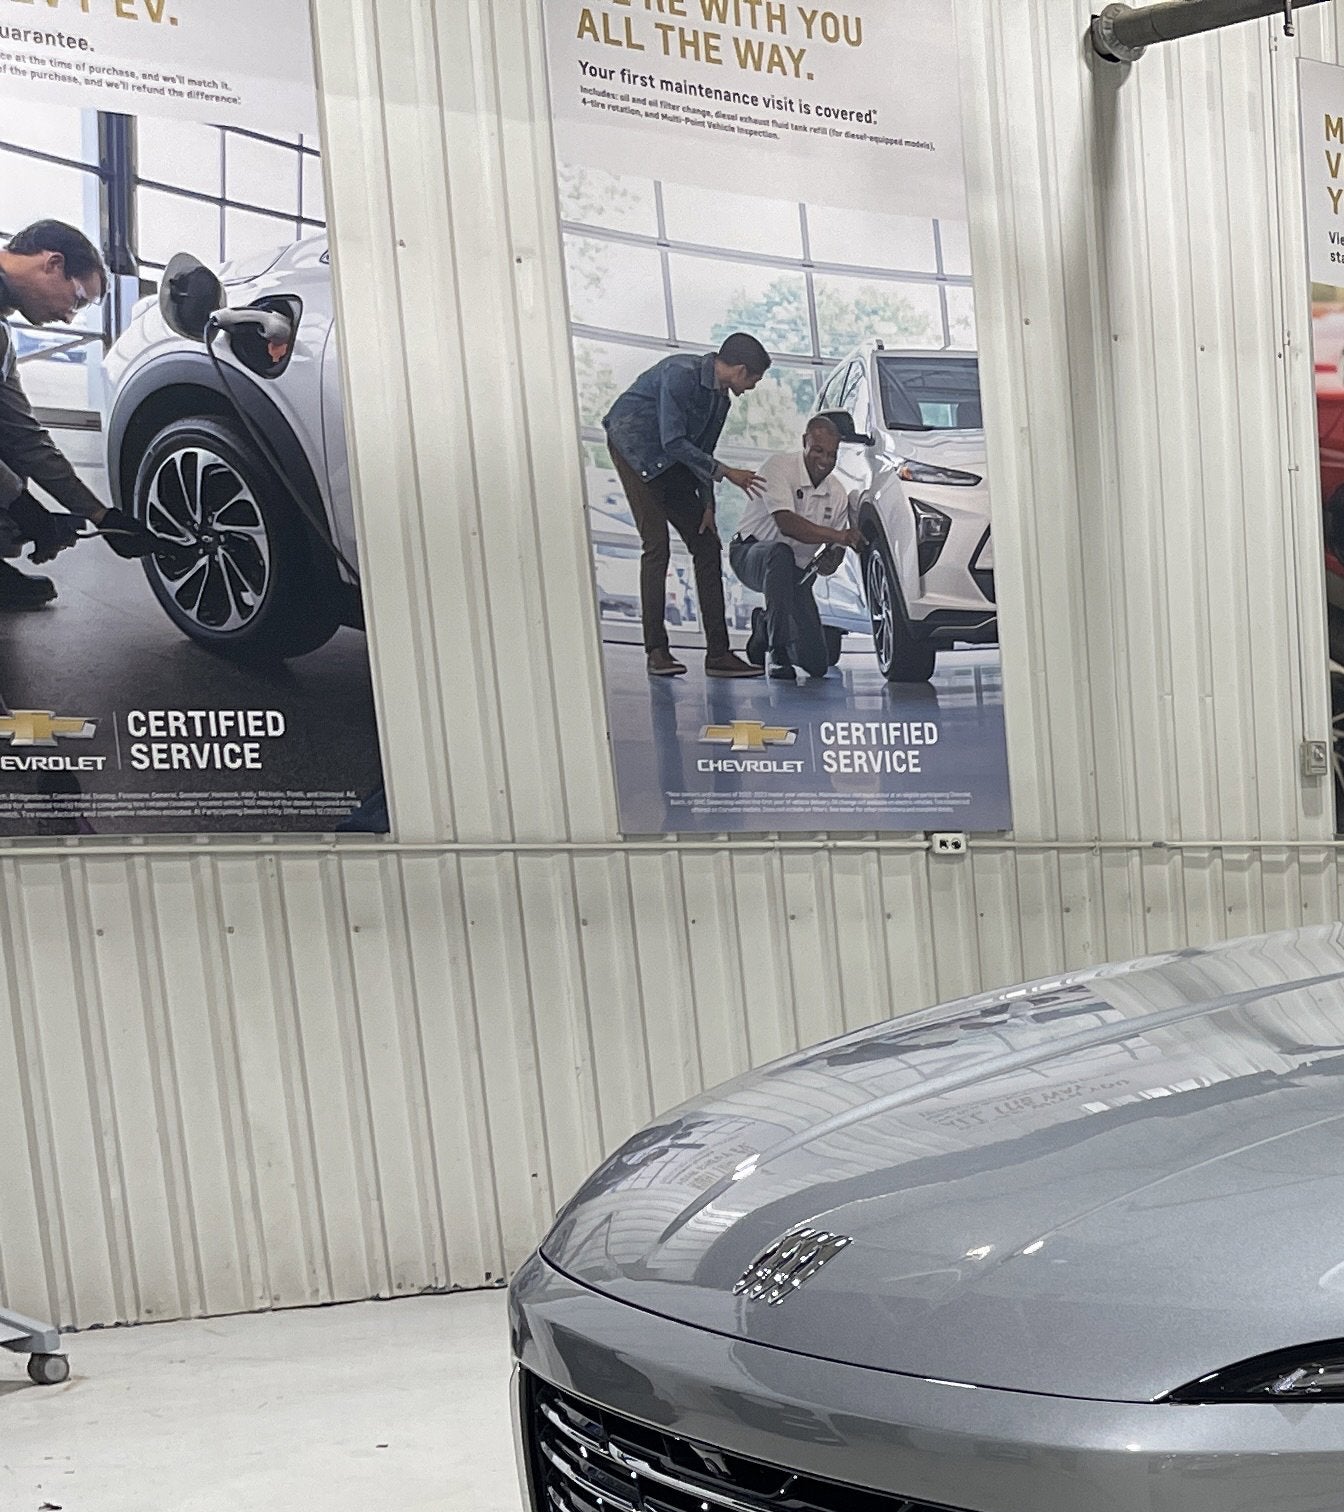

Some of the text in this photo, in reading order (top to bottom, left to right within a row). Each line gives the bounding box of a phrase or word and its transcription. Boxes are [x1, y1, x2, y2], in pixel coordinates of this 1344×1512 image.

[699, 0, 787, 36] WITH
[797, 5, 863, 48] YOU
[576, 7, 815, 81] ALL THE WAY.
[9, 66, 27, 76] the
[30, 69, 82, 86] purchase,
[84, 77, 103, 88] and
[105, 79, 129, 91] we'll
[131, 83, 166, 96] refund
[168, 86, 185, 98] the
[29, 55, 46, 66] the
[49, 58, 72, 70] time
[75, 62, 86, 72] of
[88, 64, 139, 80] purchase,
[141, 71, 160, 82] and
[162, 74, 185, 85] we'll
[187, 77, 219, 89] match
[578, 60, 616, 82] Your
[620, 69, 656, 89] first
[660, 78, 759, 108] maintenance
[762, 95, 795, 113] visit
[798, 98, 811, 115] is
[632, 96, 647, 106] and
[660, 100, 681, 112] filter
[714, 110, 738, 122] diesel
[739, 115, 770, 126] exhaust
[772, 119, 790, 130] fluid
[790, 122, 808, 133] tank
[644, 110, 660, 120] and
[707, 121, 736, 134] Vehicle
[127, 710, 287, 738] CERTIFIED
[819, 721, 938, 745] CERTIFIED
[130, 742, 263, 770] SERVICE
[697, 759, 805, 773] CHEVROLET
[822, 749, 922, 773] SERVICE
